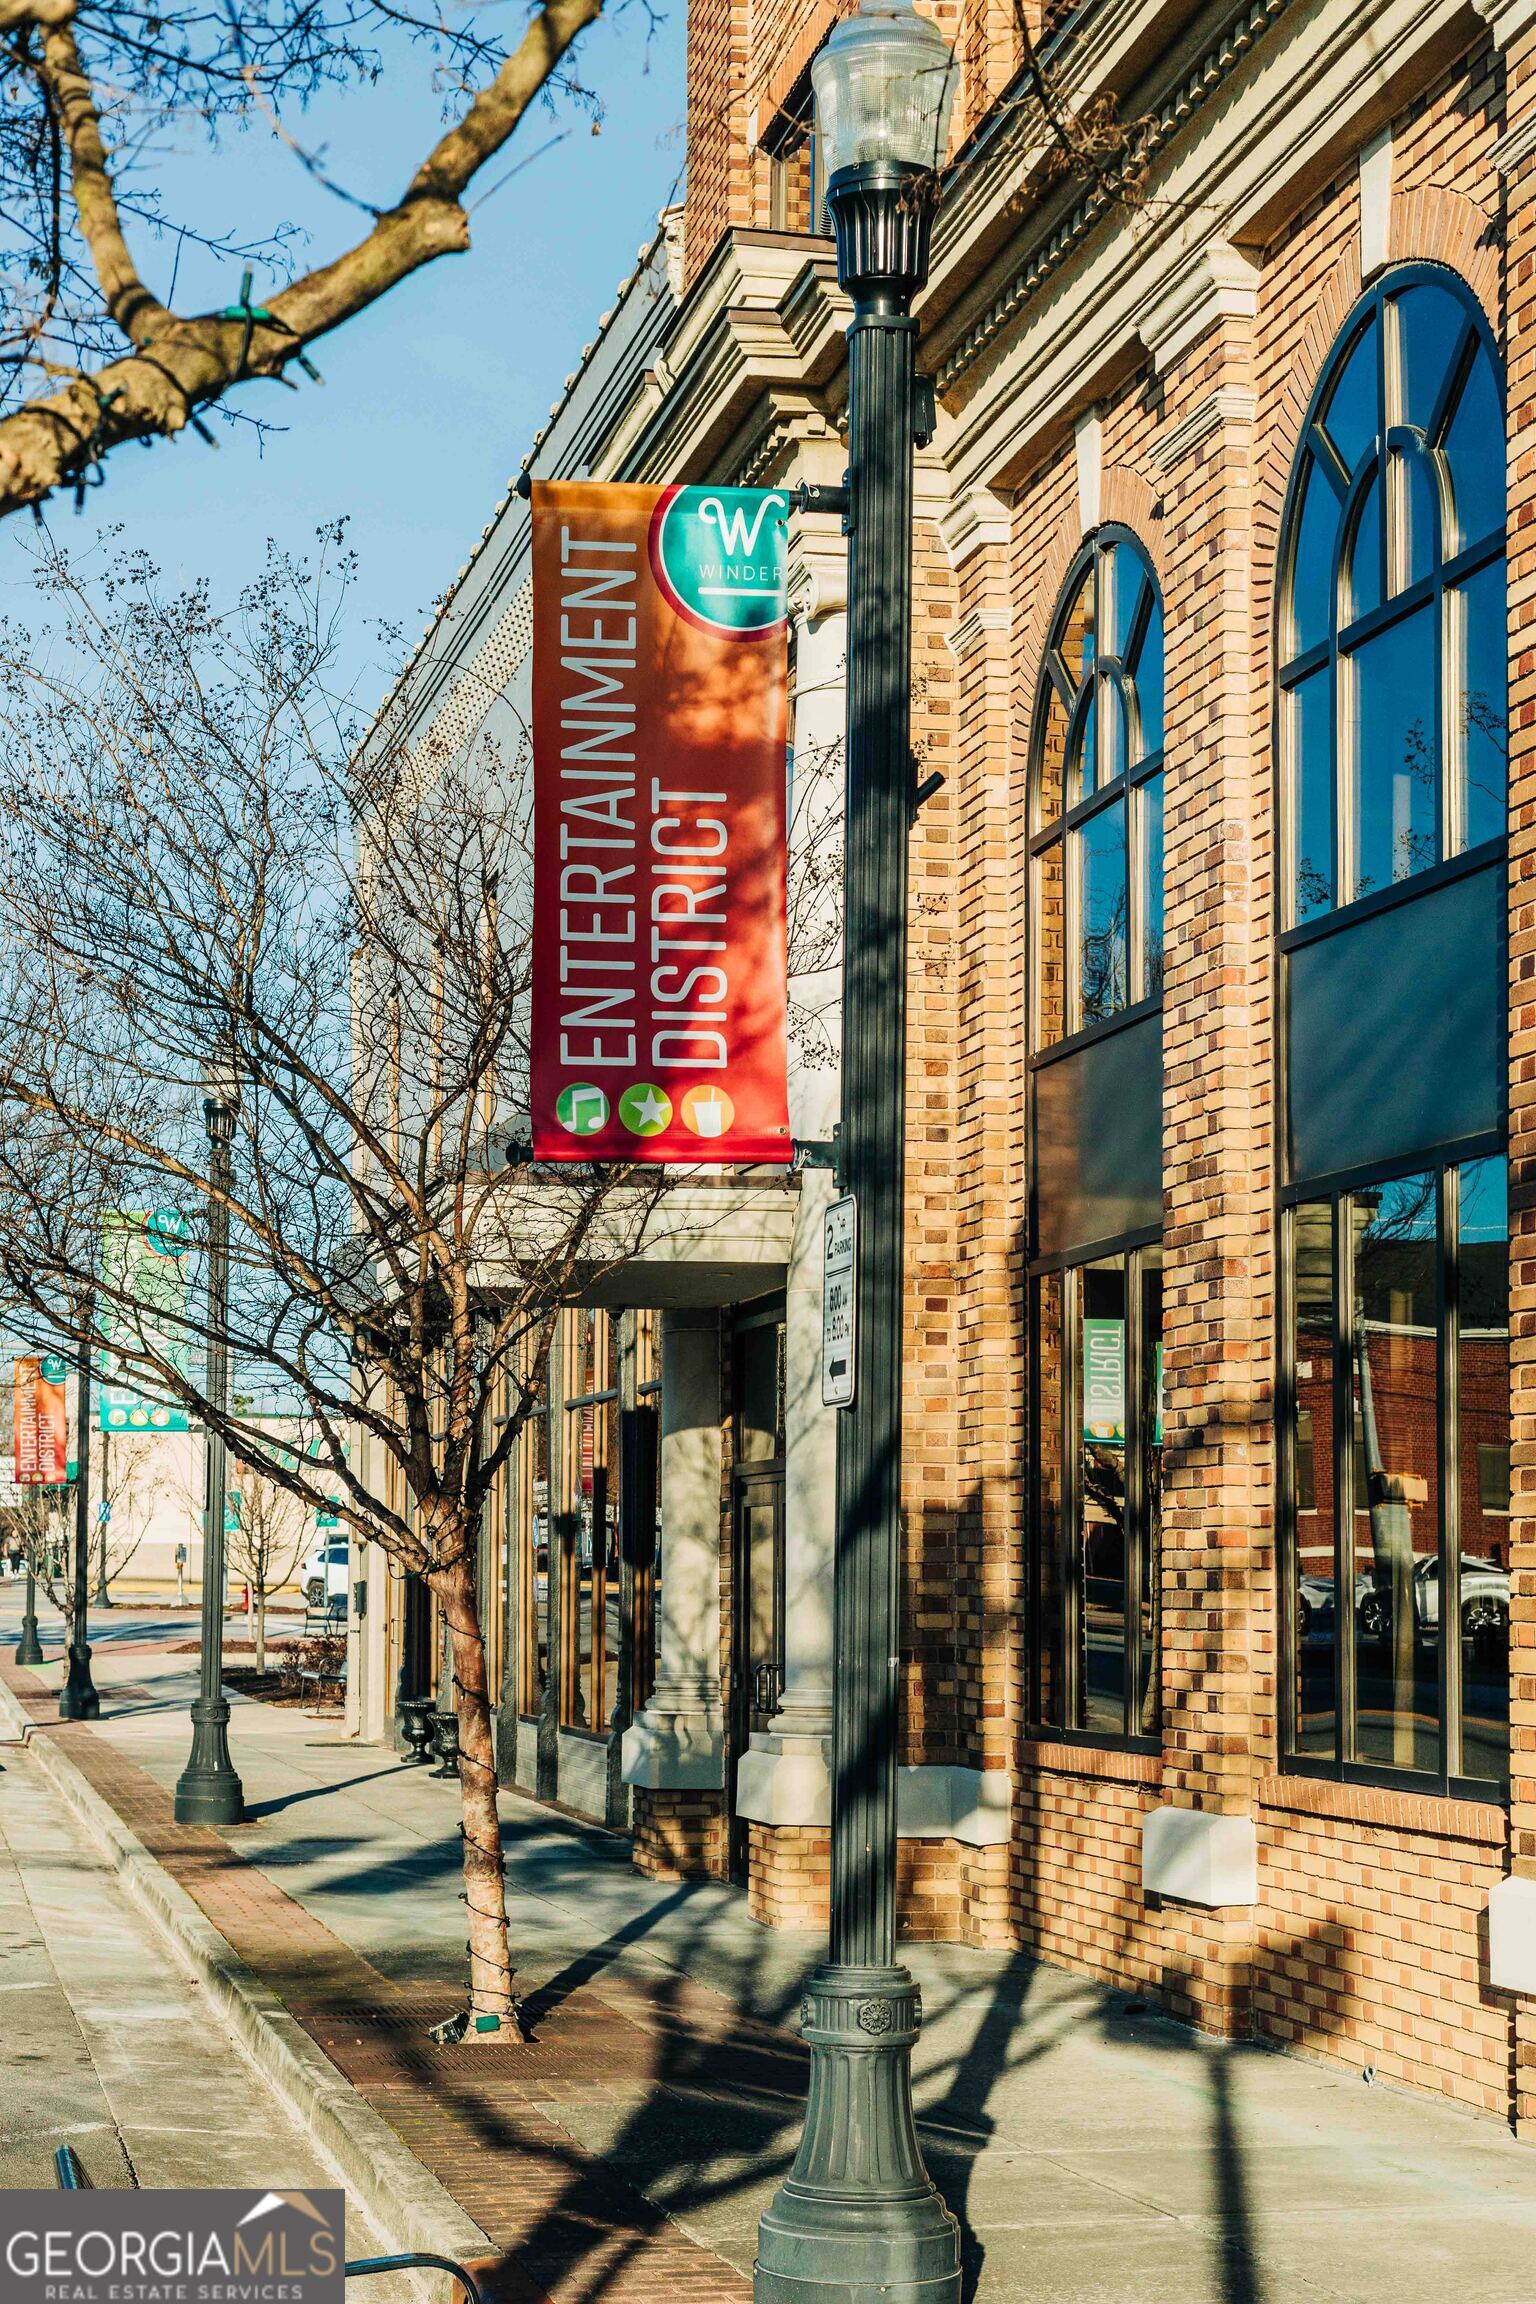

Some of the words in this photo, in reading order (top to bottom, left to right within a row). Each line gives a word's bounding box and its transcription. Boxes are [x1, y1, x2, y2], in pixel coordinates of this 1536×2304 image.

[698, 494, 785, 557] W
[699, 564, 783, 581] WINDER
[560, 526, 637, 1066] ENTERTAINMENT
[650, 777, 728, 1069] DISTRICT
[827, 1224, 834, 1260] 2
[834, 1236, 852, 1257] PARKING
[19, 1364, 37, 1471] ENTERTAINMENT
[38, 1413, 56, 1472] DISTRICT
